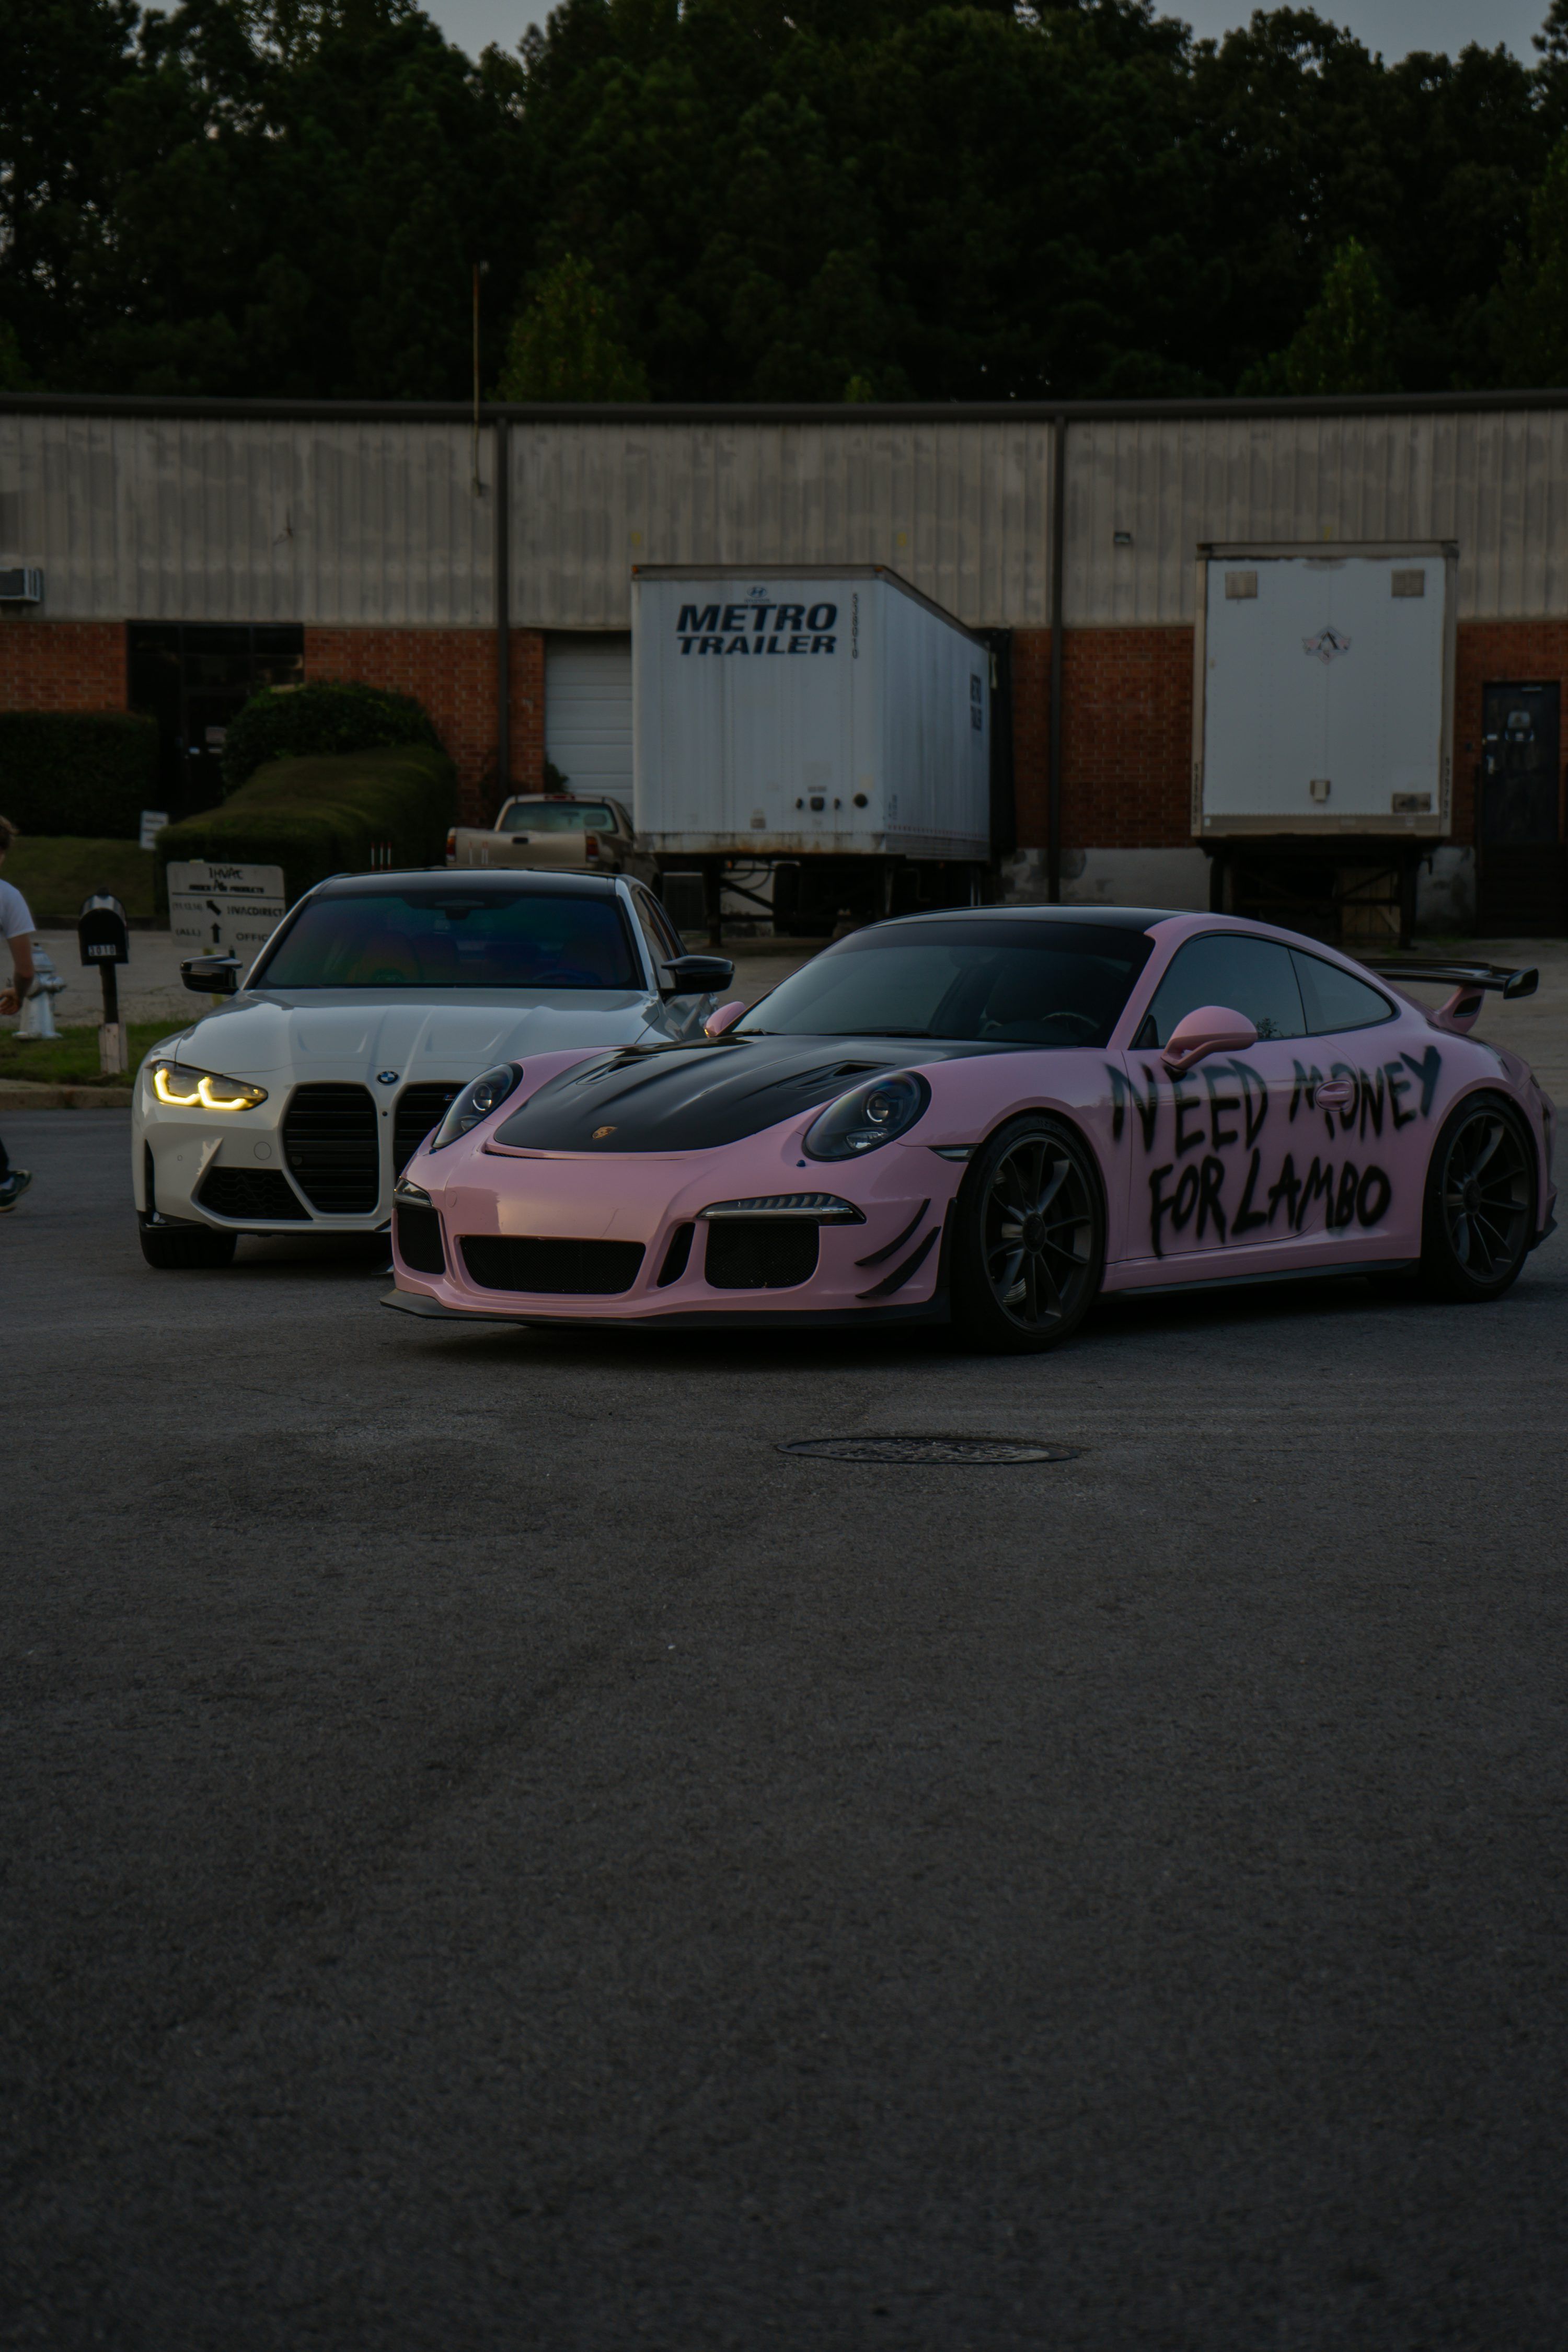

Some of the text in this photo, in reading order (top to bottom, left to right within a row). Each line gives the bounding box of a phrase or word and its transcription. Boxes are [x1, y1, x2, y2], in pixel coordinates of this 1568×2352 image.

[676, 604, 837, 632] METRO
[677, 636, 837, 655] TRAILER
[236, 932, 269, 943] OFFIC
[1104, 1045, 1442, 1157] NEED MONEY
[1149, 1148, 1391, 1260] FOR LAMBO
